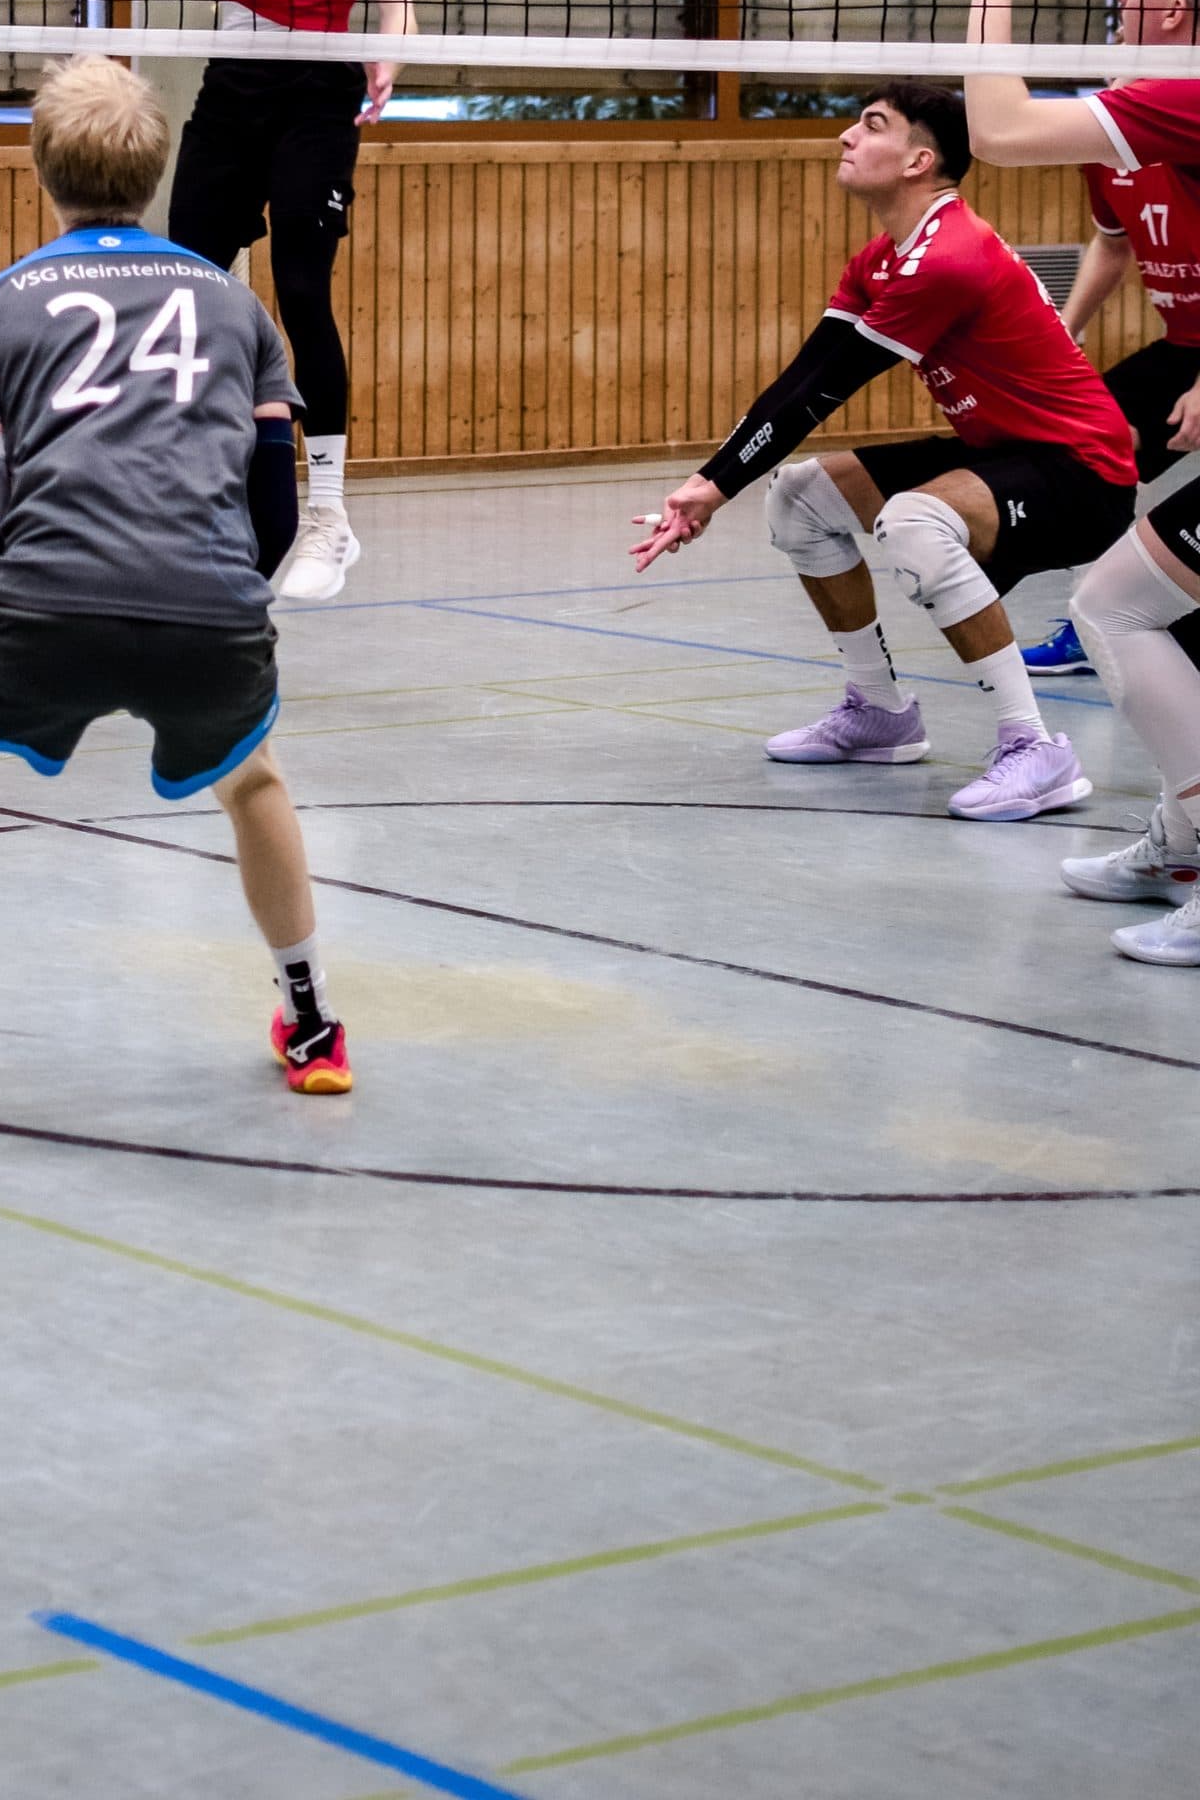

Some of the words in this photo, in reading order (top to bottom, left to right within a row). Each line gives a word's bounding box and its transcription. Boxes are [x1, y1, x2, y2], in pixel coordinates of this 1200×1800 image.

[1140, 203, 1168, 247] 17
[10, 267, 58, 291] VSG
[62, 262, 229, 287] Kleinsteinbach
[45, 288, 210, 411] 24
[749, 421, 774, 453] cep
[1179, 528, 1200, 554] erim
